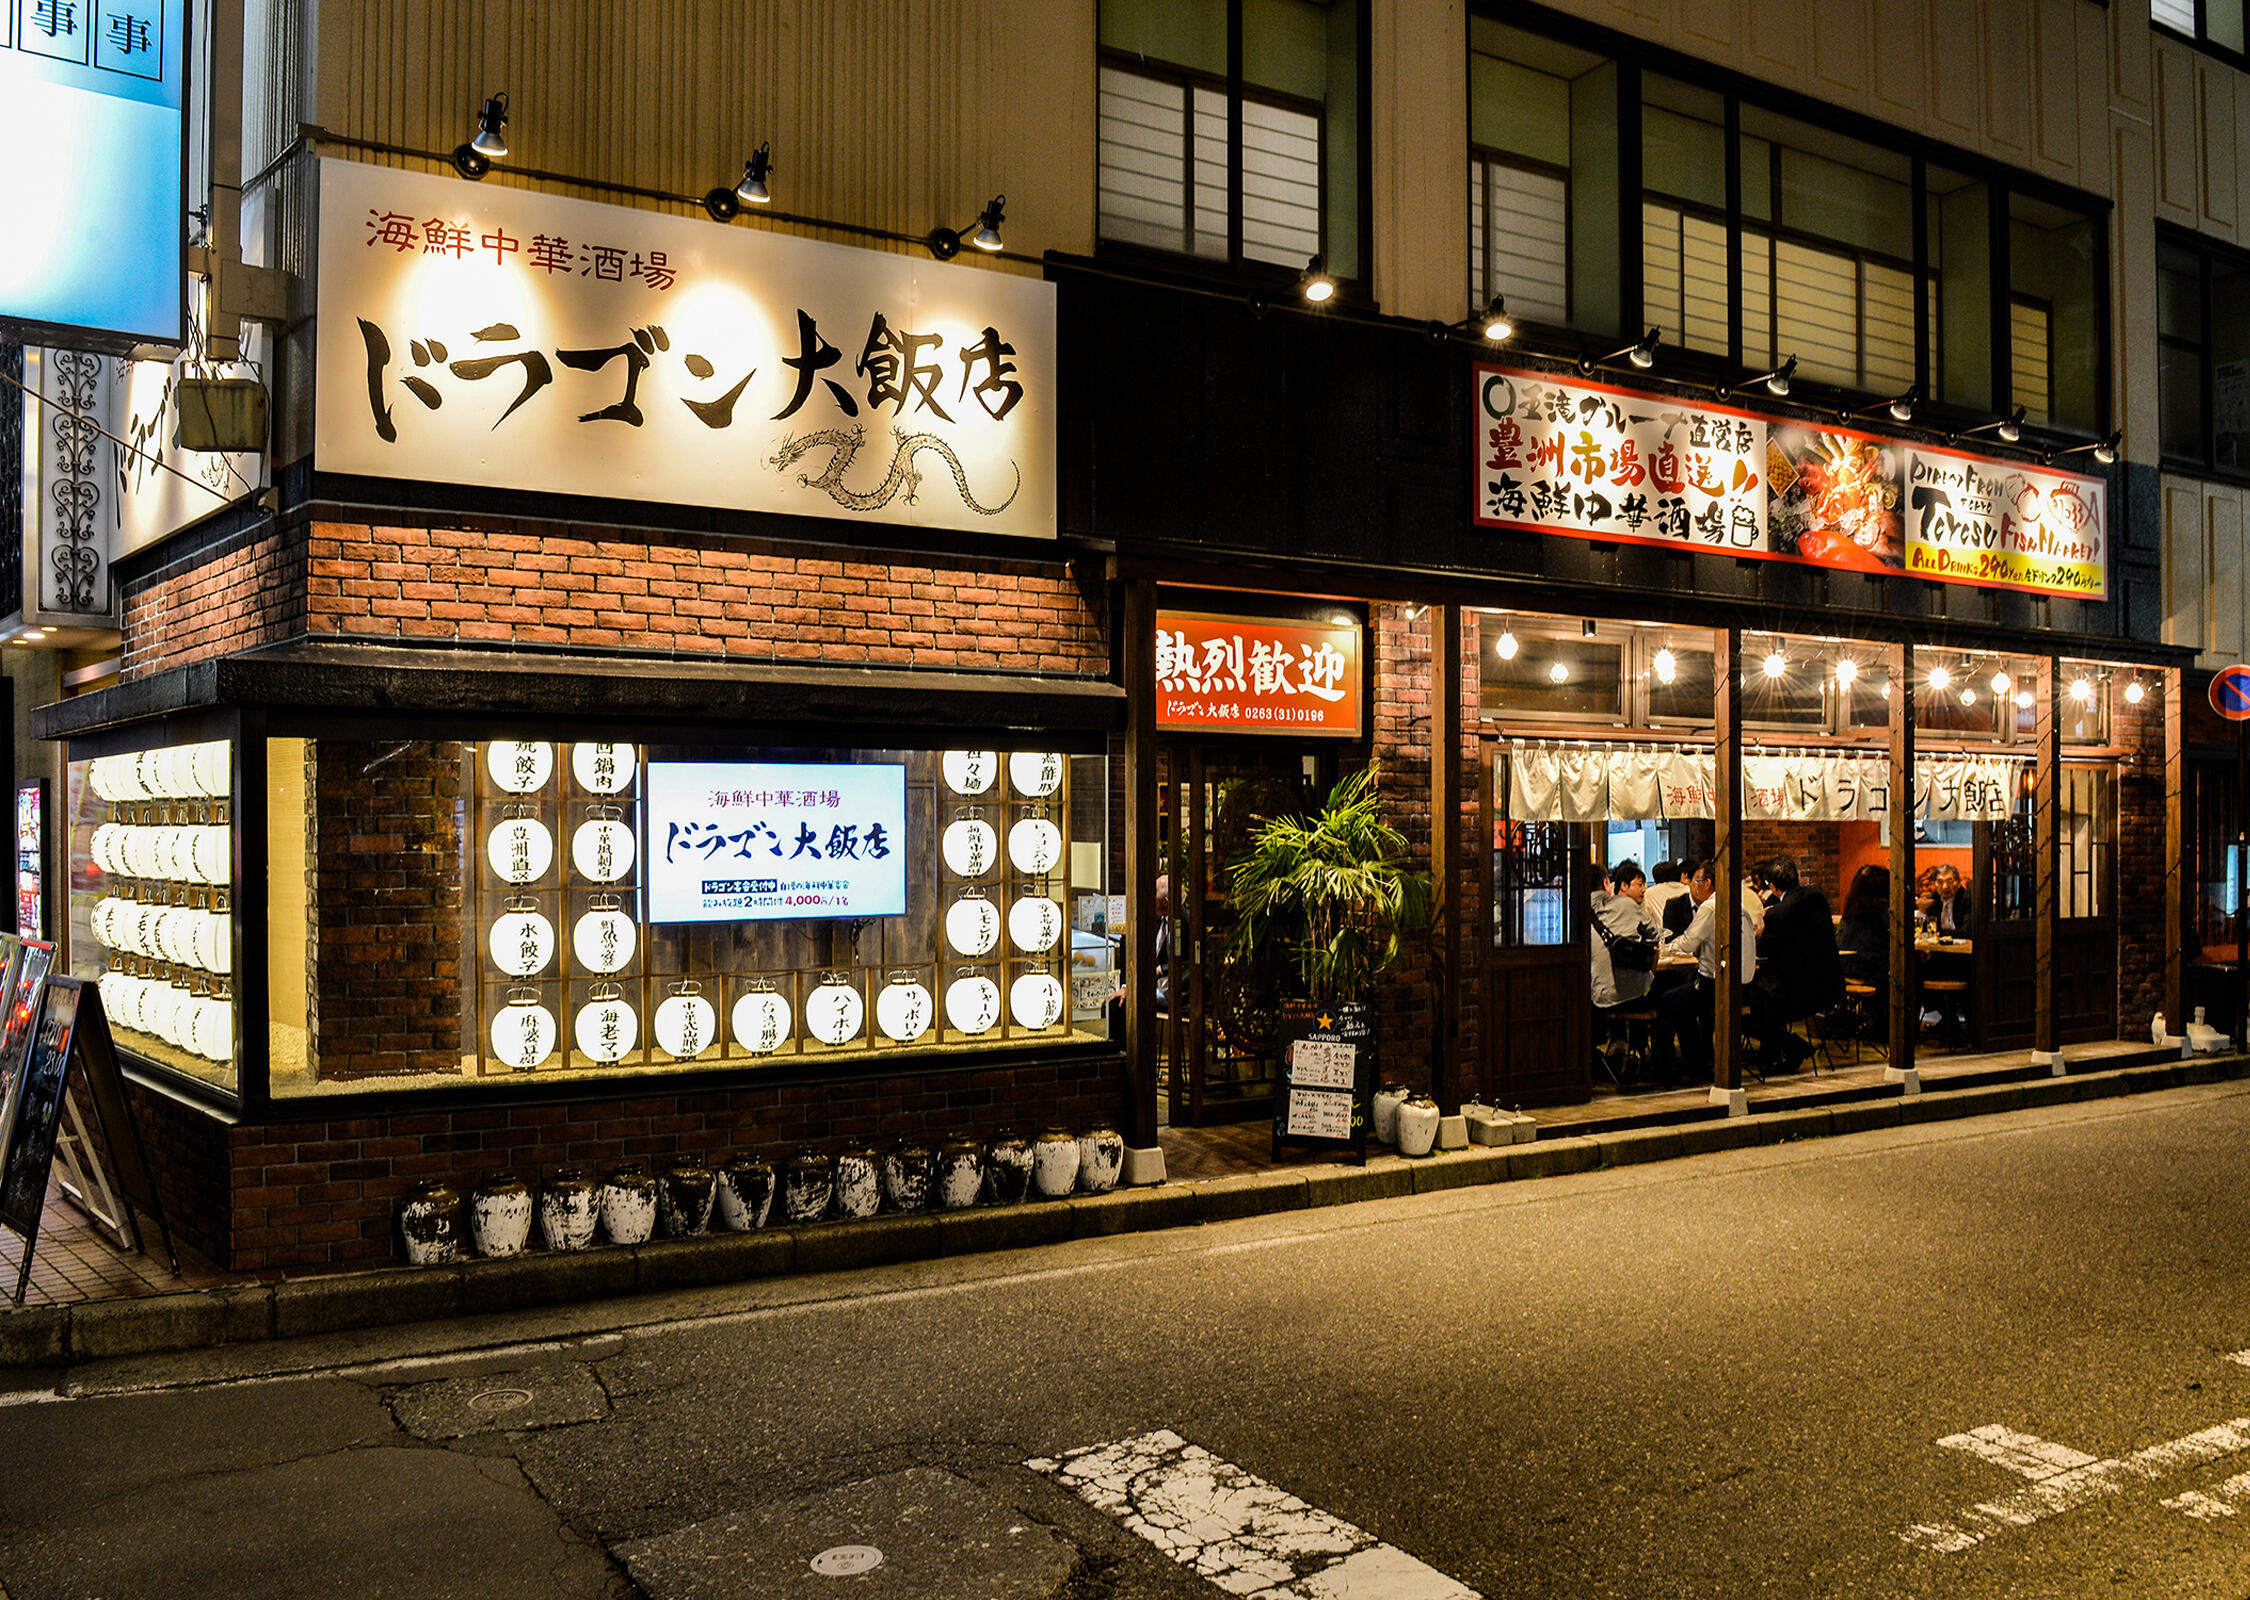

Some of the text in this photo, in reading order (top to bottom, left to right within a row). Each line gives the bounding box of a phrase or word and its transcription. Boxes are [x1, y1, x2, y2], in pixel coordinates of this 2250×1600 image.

[365, 208, 677, 291] 海鮮中華酒場
[357, 307, 1025, 443] ドラゴン大飯店
[1486, 472, 1727, 544] 海鮮中華酒場
[1912, 486, 1998, 549] TOYOSU
[2001, 512, 2038, 552] FISH
[1912, 547, 1937, 570] ALL
[1156, 629, 1347, 702] 熱烈歓迎
[1167, 700, 1240, 719] ドラゴン大飯店
[708, 790, 841, 808] 海鮮中華酒場
[666, 820, 891, 864] ドラゴン大飯店
[518, 923, 539, 972] 水餃子
[1308, 1033, 1341, 1042] SAPPORO
